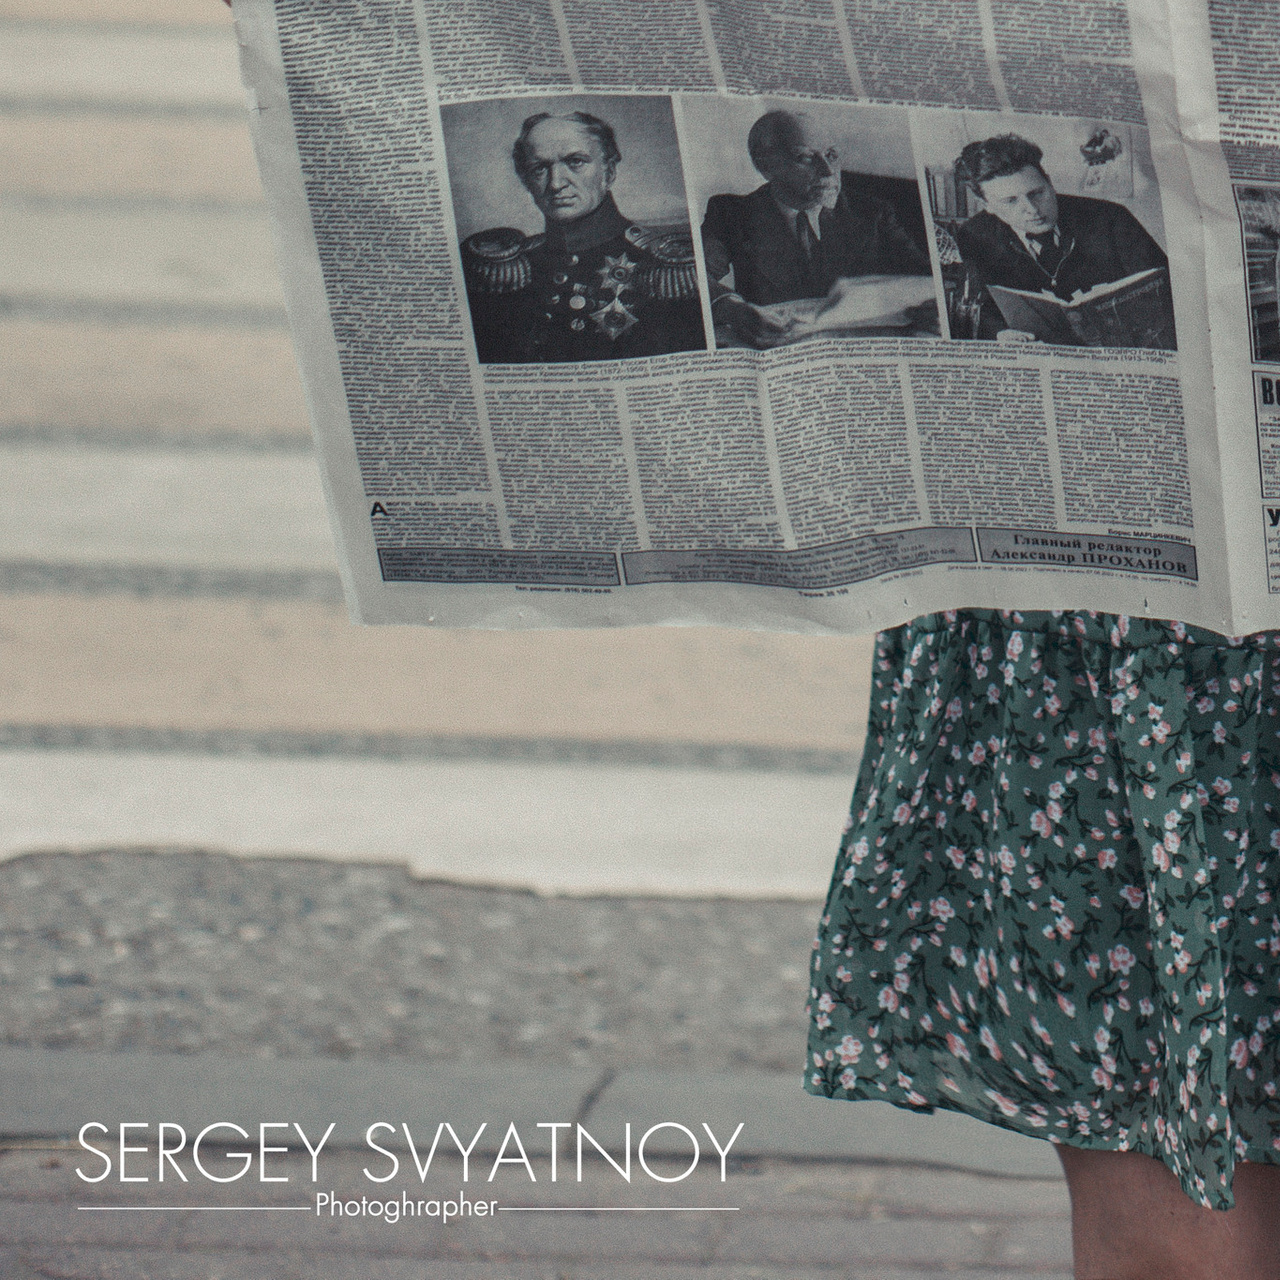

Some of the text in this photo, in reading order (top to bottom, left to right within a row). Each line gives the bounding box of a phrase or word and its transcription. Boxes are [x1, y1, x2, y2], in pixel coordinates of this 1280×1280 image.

[1013, 533, 1162, 558] Главный редактор
[990, 547, 1188, 574] Александр ПРОХАНОВ
